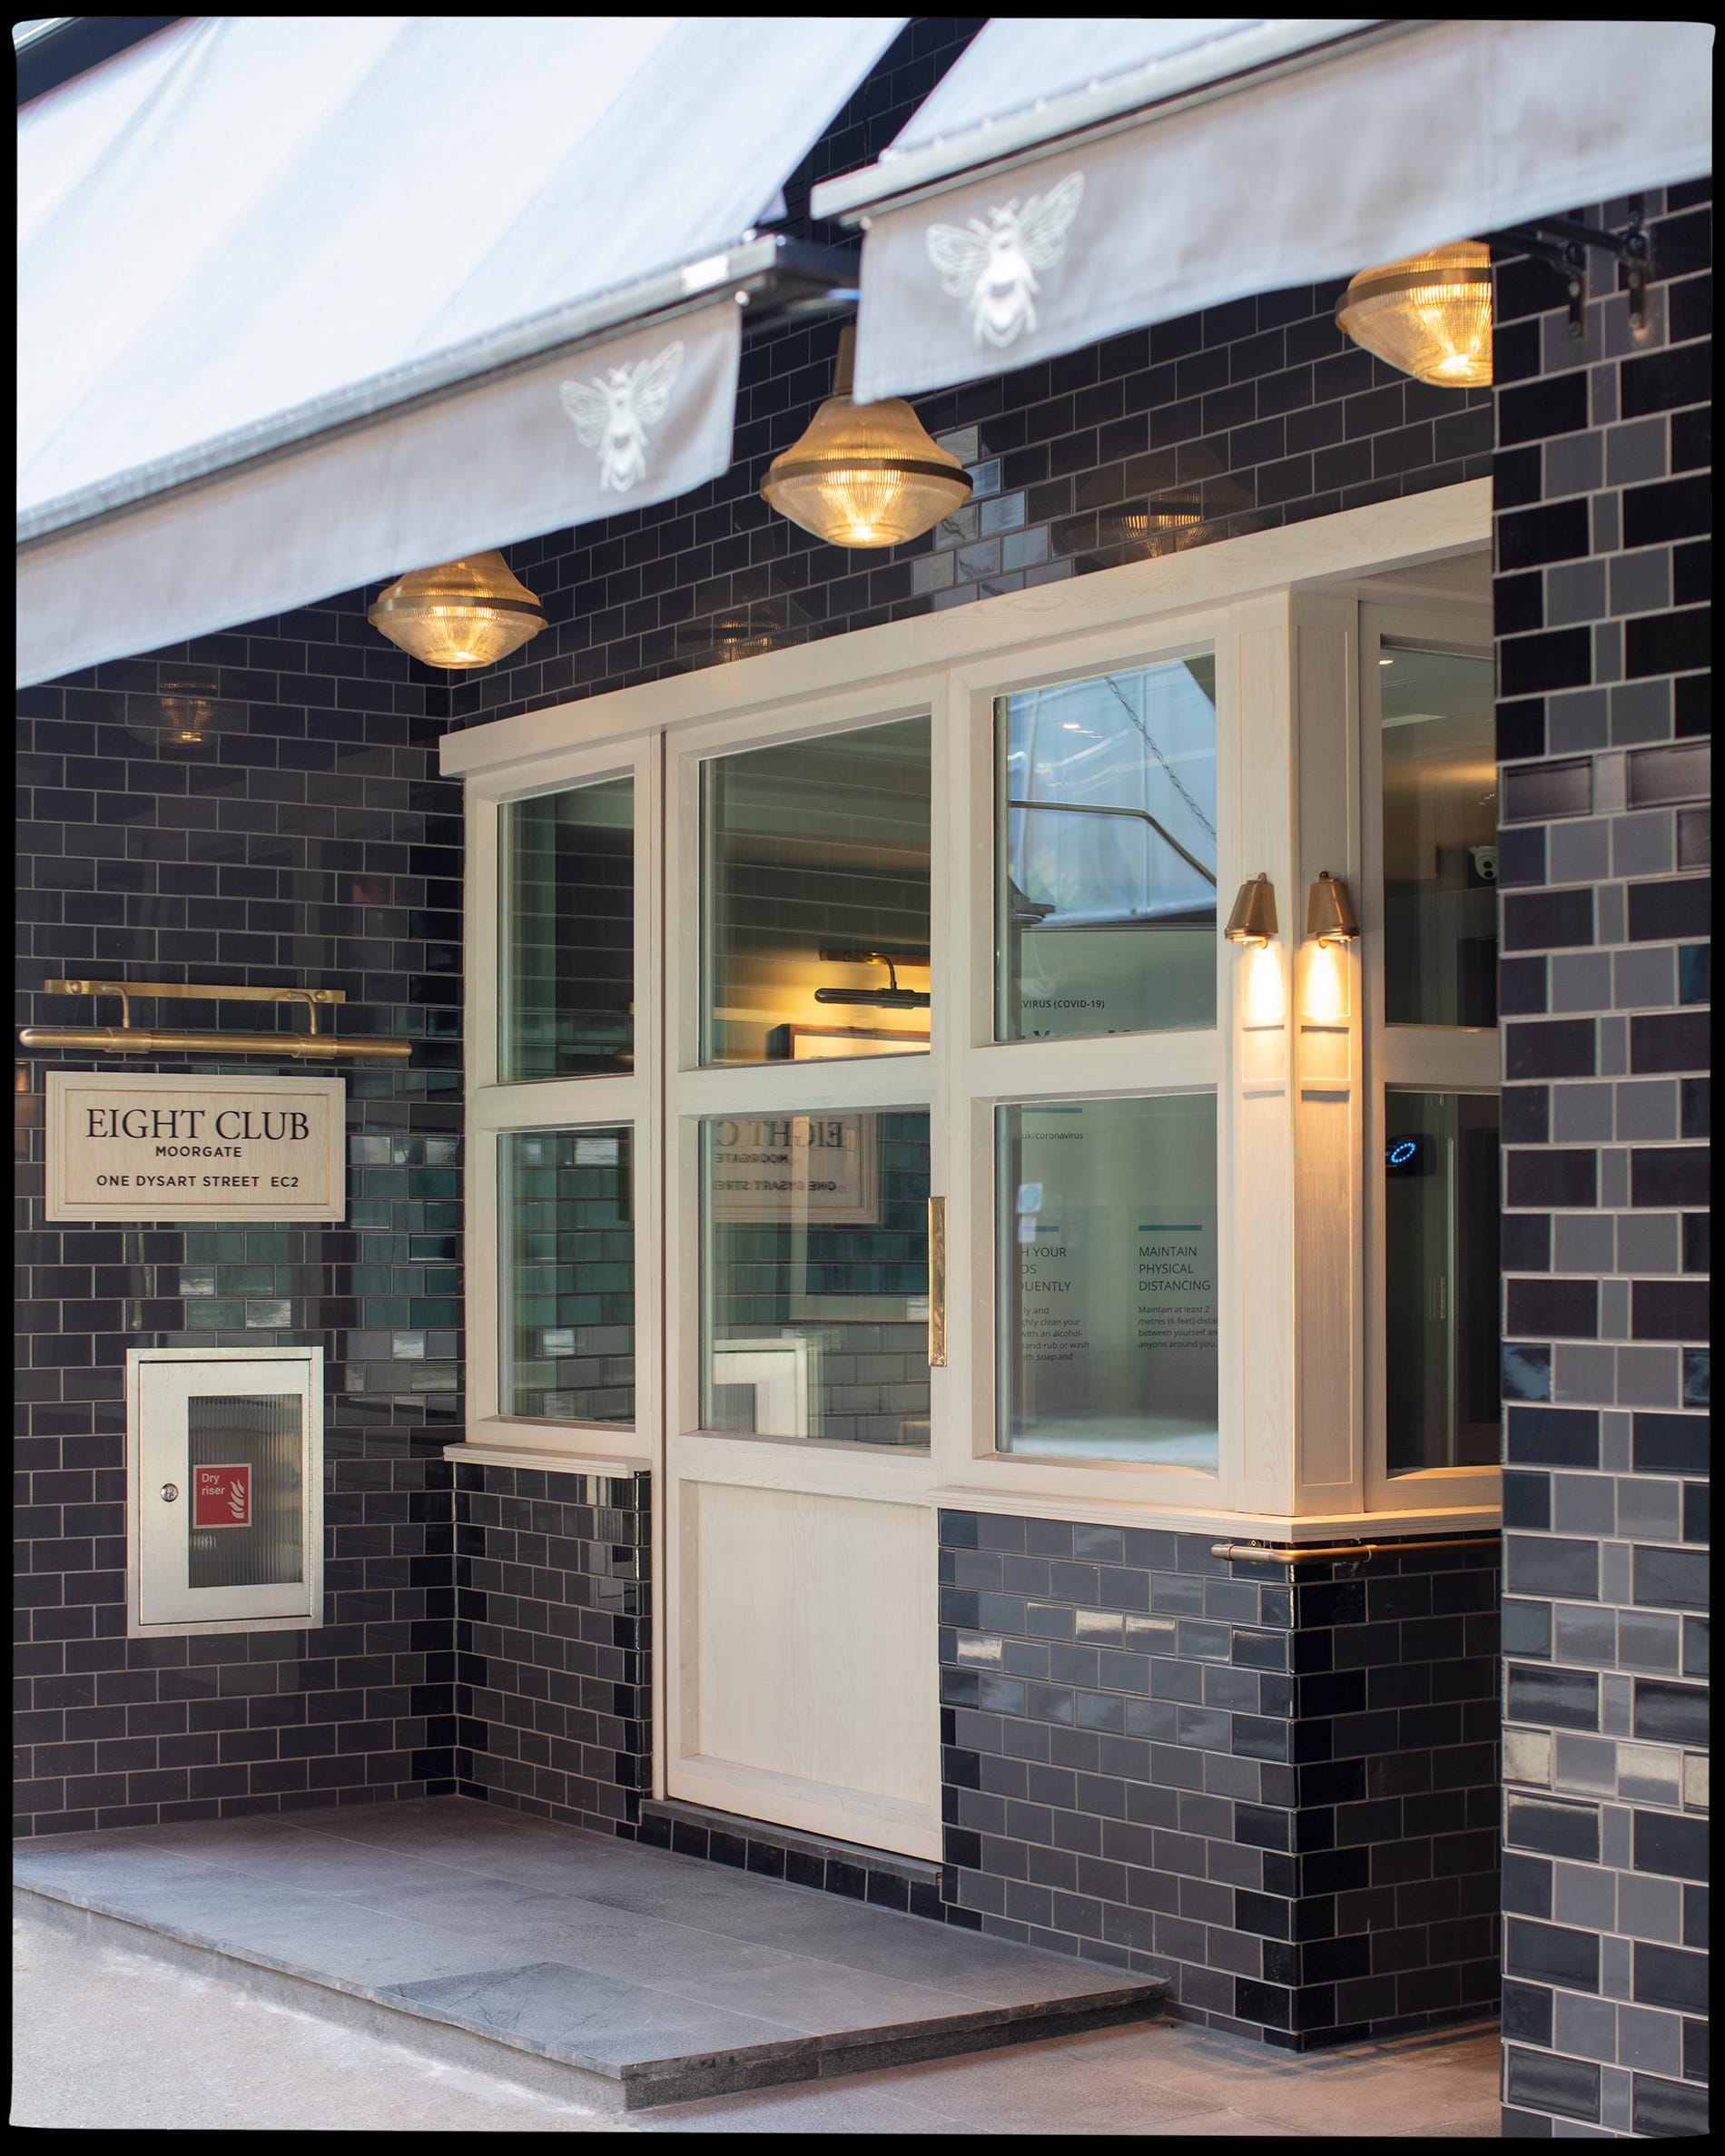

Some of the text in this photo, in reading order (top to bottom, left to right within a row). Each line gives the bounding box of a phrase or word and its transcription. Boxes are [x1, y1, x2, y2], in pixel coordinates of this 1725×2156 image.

[1021, 999, 1105, 1009] VIRUS (COVID-19)
[86, 1108, 310, 1140] EIGHT CLUB
[155, 1146, 242, 1158] MOORGATE
[96, 1175, 299, 1187] ONE DYSART STREET EC2
[1032, 1247, 1067, 1257] YOUR
[1139, 1246, 1198, 1256] MAINTAIN
[1139, 1263, 1194, 1274] PHYSICAL
[1021, 1281, 1071, 1292] UENTLY
[1139, 1280, 1211, 1291] DISTANCING
[1138, 1305, 1172, 1314] Maintain
[1185, 1305, 1203, 1314] least
[1205, 1305, 1210, 1314] 2
[1178, 1317, 1196, 1325] feet)
[1053, 1329, 1083, 1337] alcohol-
[1138, 1329, 1172, 1337] between
[1174, 1328, 1207, 1338] yourself
[1070, 1341, 1089, 1349] wash
[1138, 1342, 1168, 1350] anyone
[1037, 1354, 1057, 1362] soap
[202, 1473, 220, 1484] Dry
[202, 1486, 225, 1495] riser
